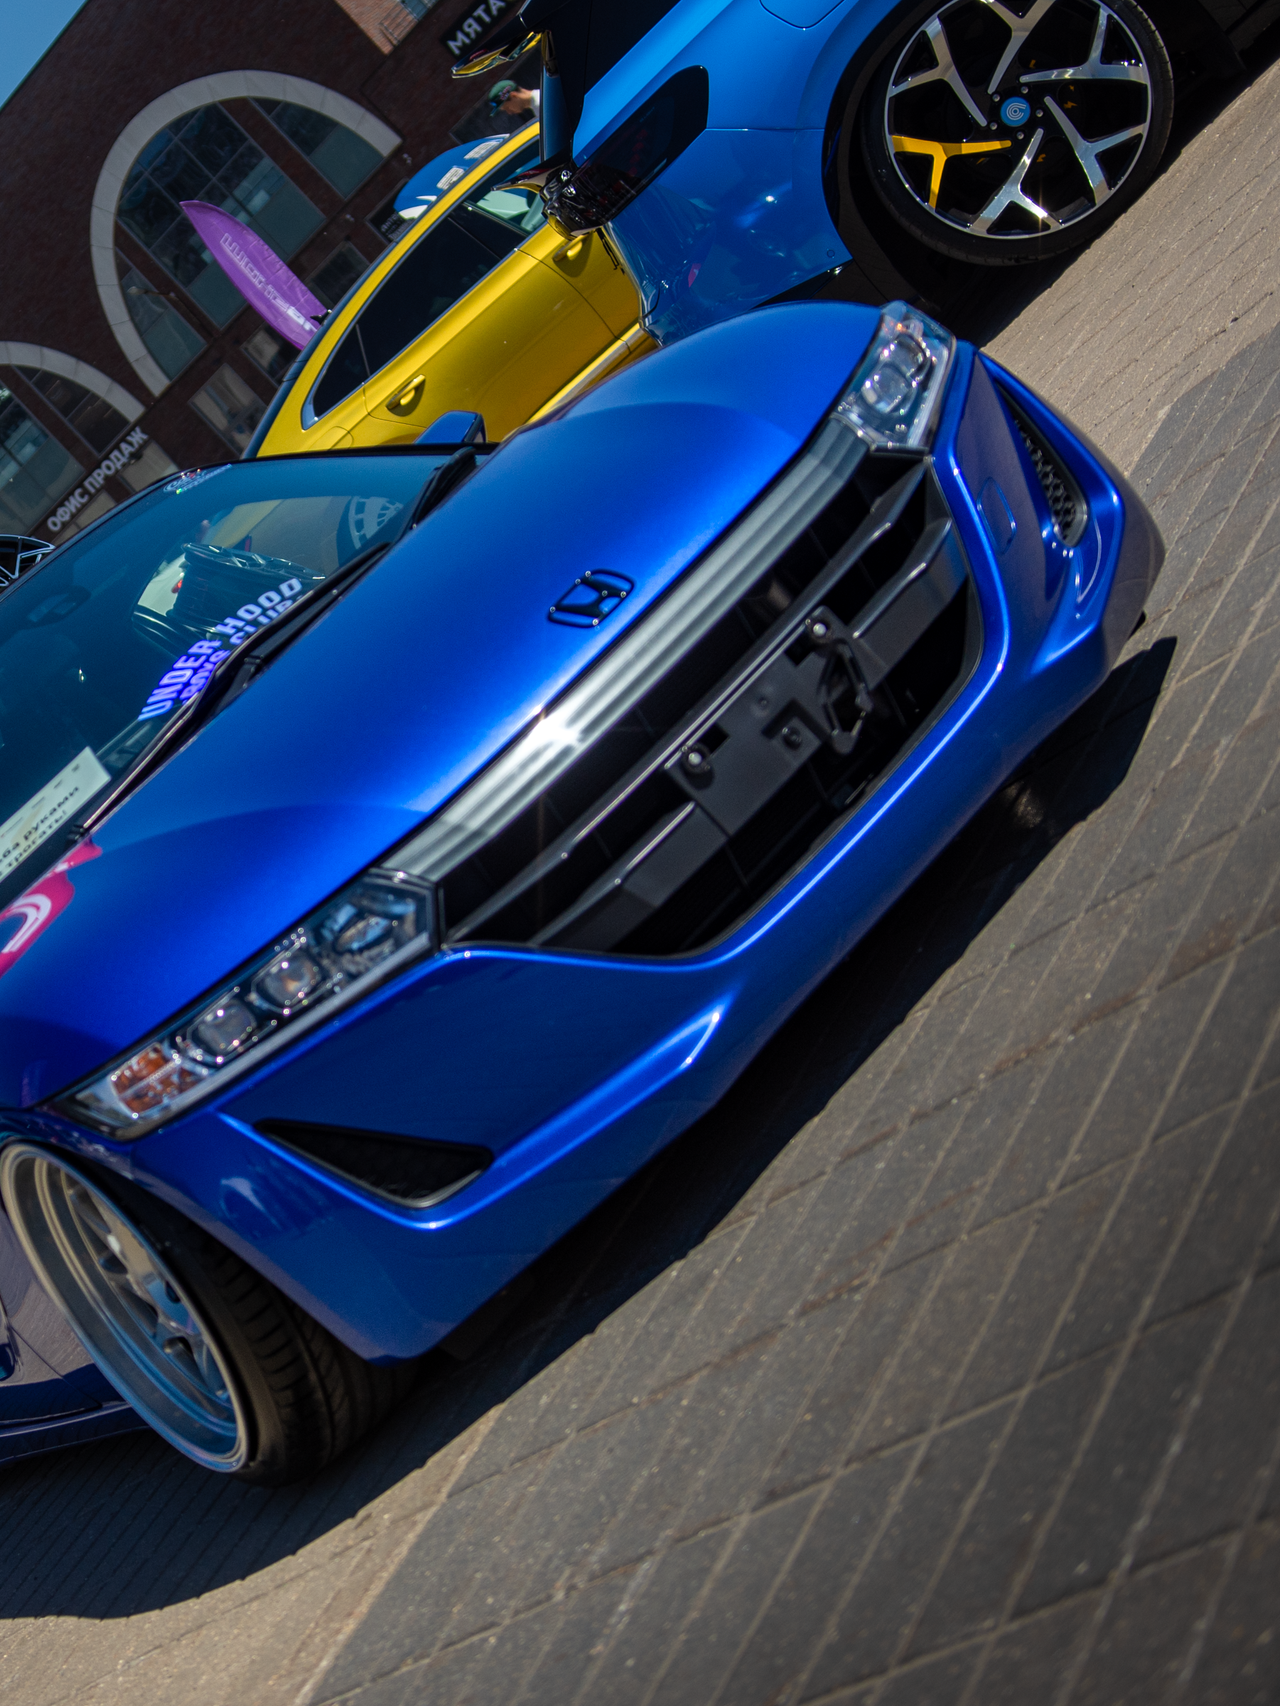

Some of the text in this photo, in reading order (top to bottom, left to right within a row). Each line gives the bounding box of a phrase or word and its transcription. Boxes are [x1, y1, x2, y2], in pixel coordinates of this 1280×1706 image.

[46, 425, 149, 533] ОФИС ПРОДАЖ
[137, 577, 303, 722] UNDER HOOD
[23, 786, 79, 841] руками
